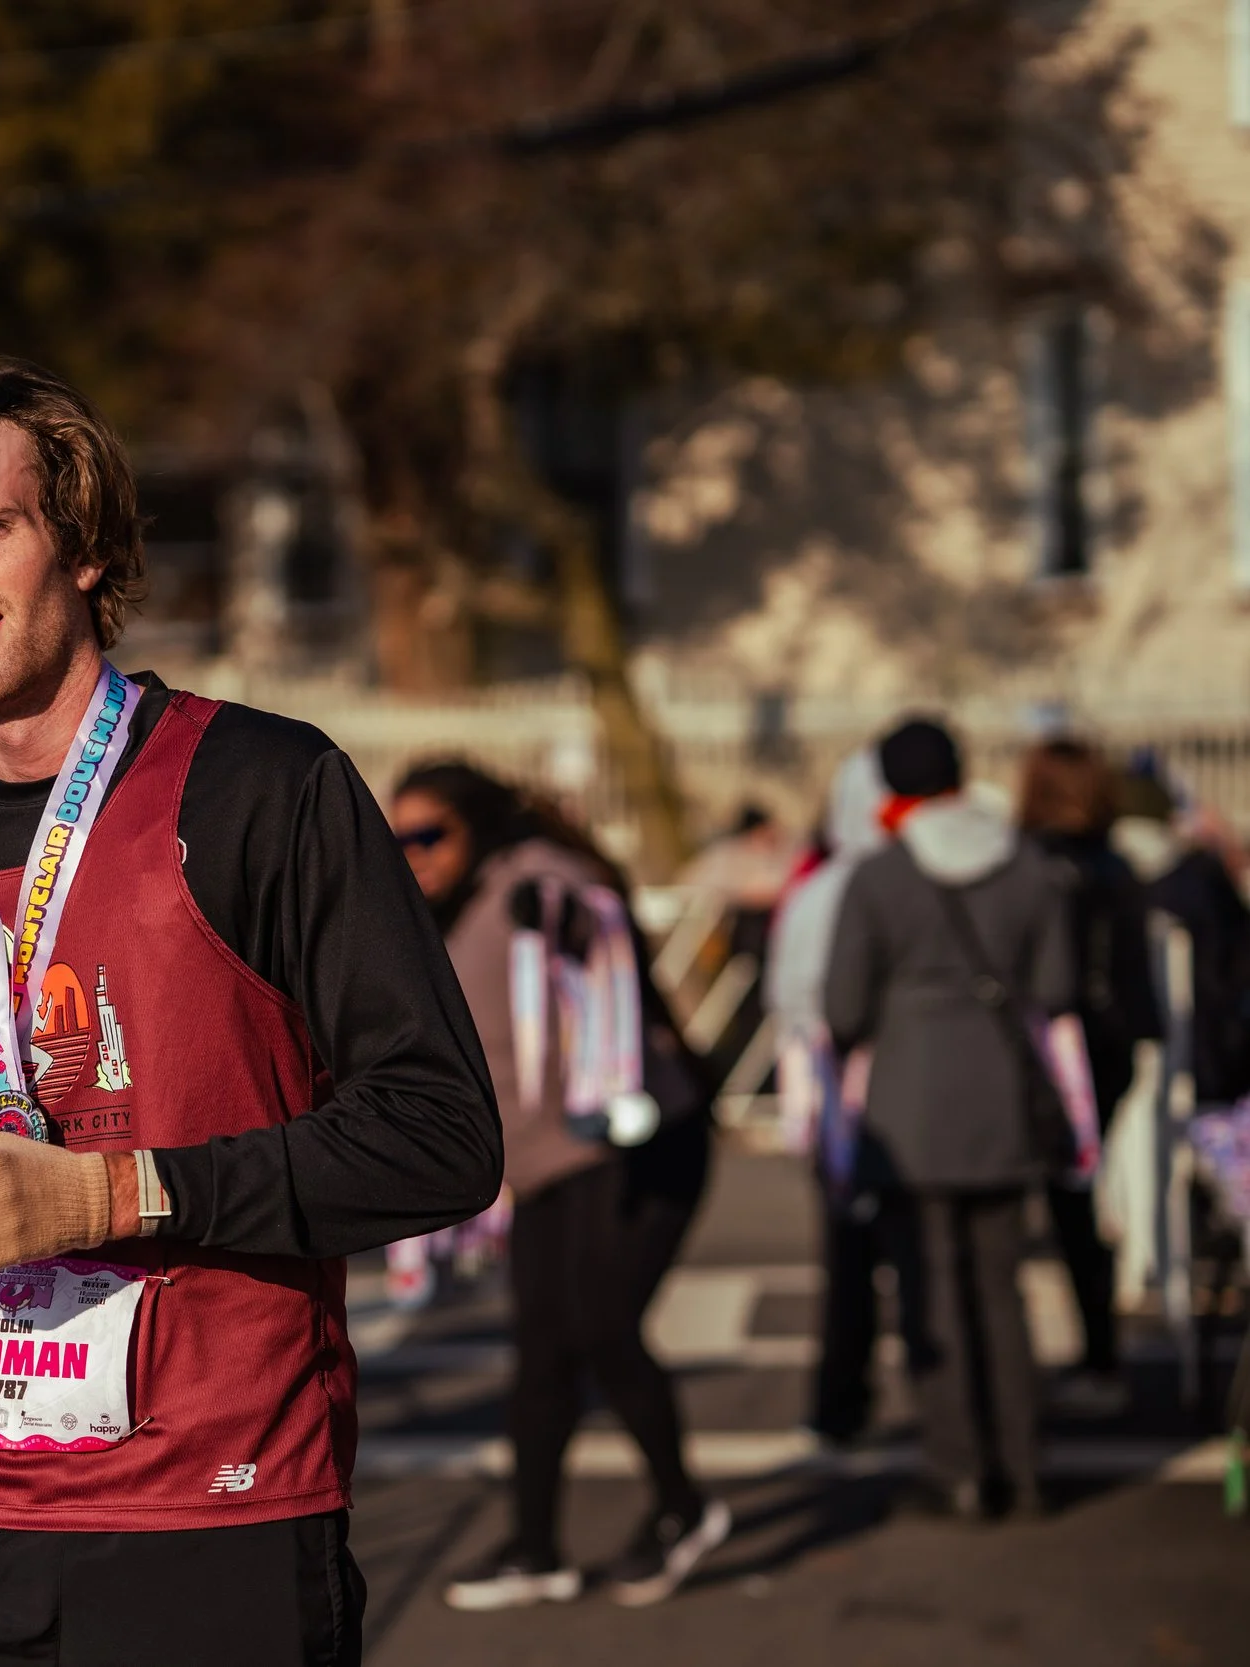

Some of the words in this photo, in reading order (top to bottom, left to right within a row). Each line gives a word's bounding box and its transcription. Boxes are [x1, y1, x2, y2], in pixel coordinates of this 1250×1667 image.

[14, 824, 74, 985] MONTCLAIR
[55, 671, 128, 823] DOUGHNUT
[61, 1117, 84, 1133] RK
[92, 1112, 131, 1129] CITY
[89, 1423, 121, 1435] happy
[20, 1438, 41, 1449] MILES
[44, 1440, 70, 1451] TRIALS
[74, 1441, 83, 1449] OF
